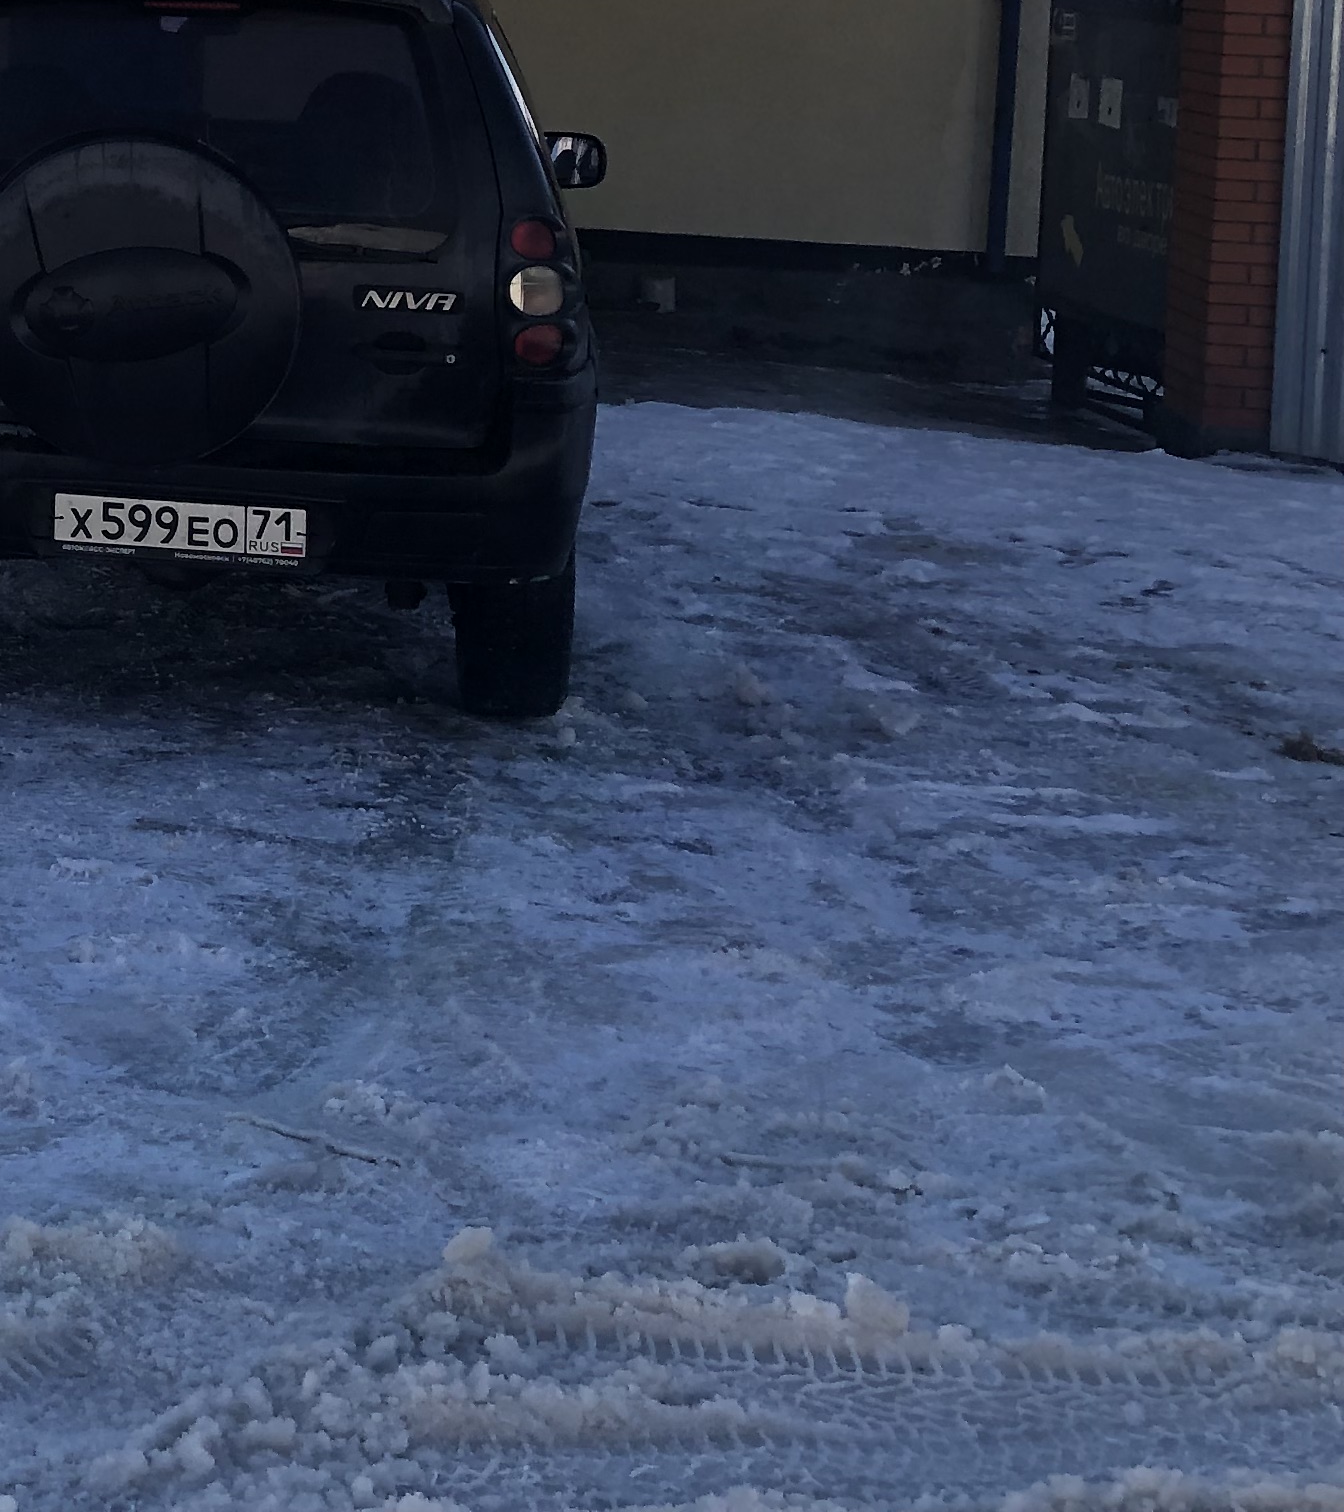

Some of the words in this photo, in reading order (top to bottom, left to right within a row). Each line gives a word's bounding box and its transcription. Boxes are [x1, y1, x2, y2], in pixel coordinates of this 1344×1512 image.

[361, 289, 457, 311] NIVA
[252, 509, 291, 541] 71
[248, 540, 279, 552] RUS
